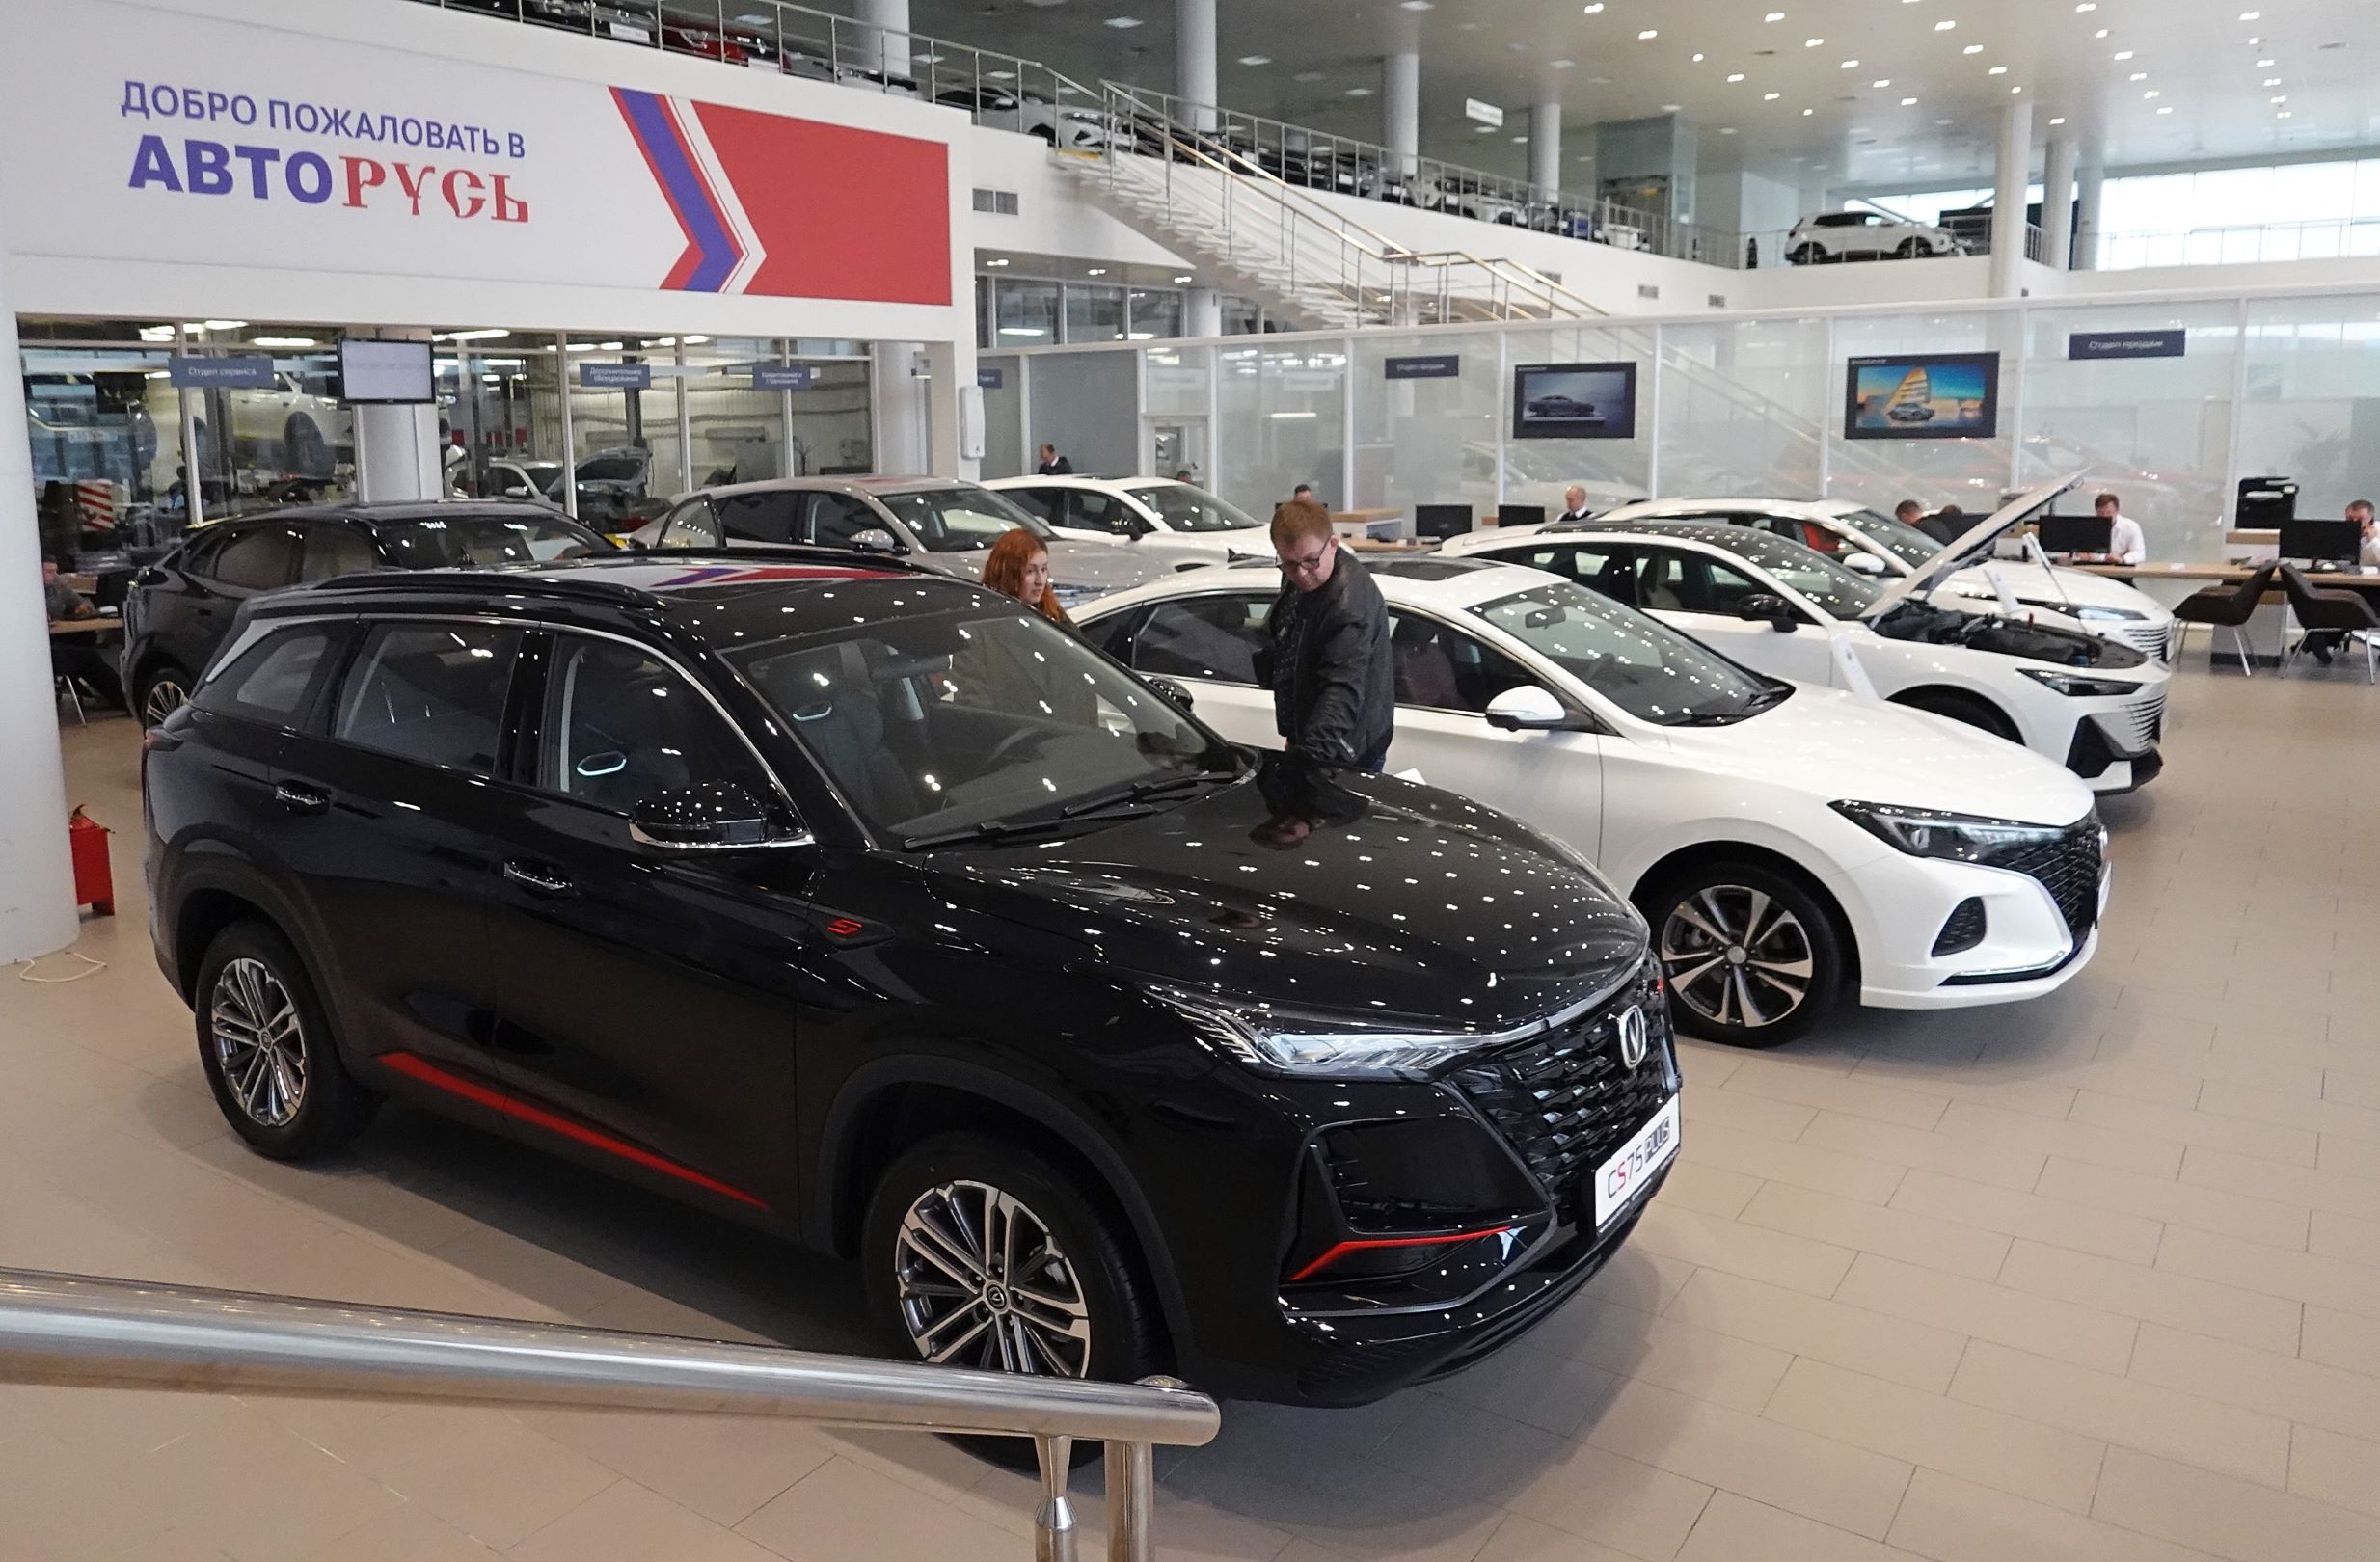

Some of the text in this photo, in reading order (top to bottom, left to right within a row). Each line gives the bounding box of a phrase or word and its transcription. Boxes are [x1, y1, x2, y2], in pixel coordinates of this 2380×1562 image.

[121, 81, 525, 158] ДОБРО ПОЖАЛОВАТЬ В
[1607, 1144, 1643, 1198] CS75
